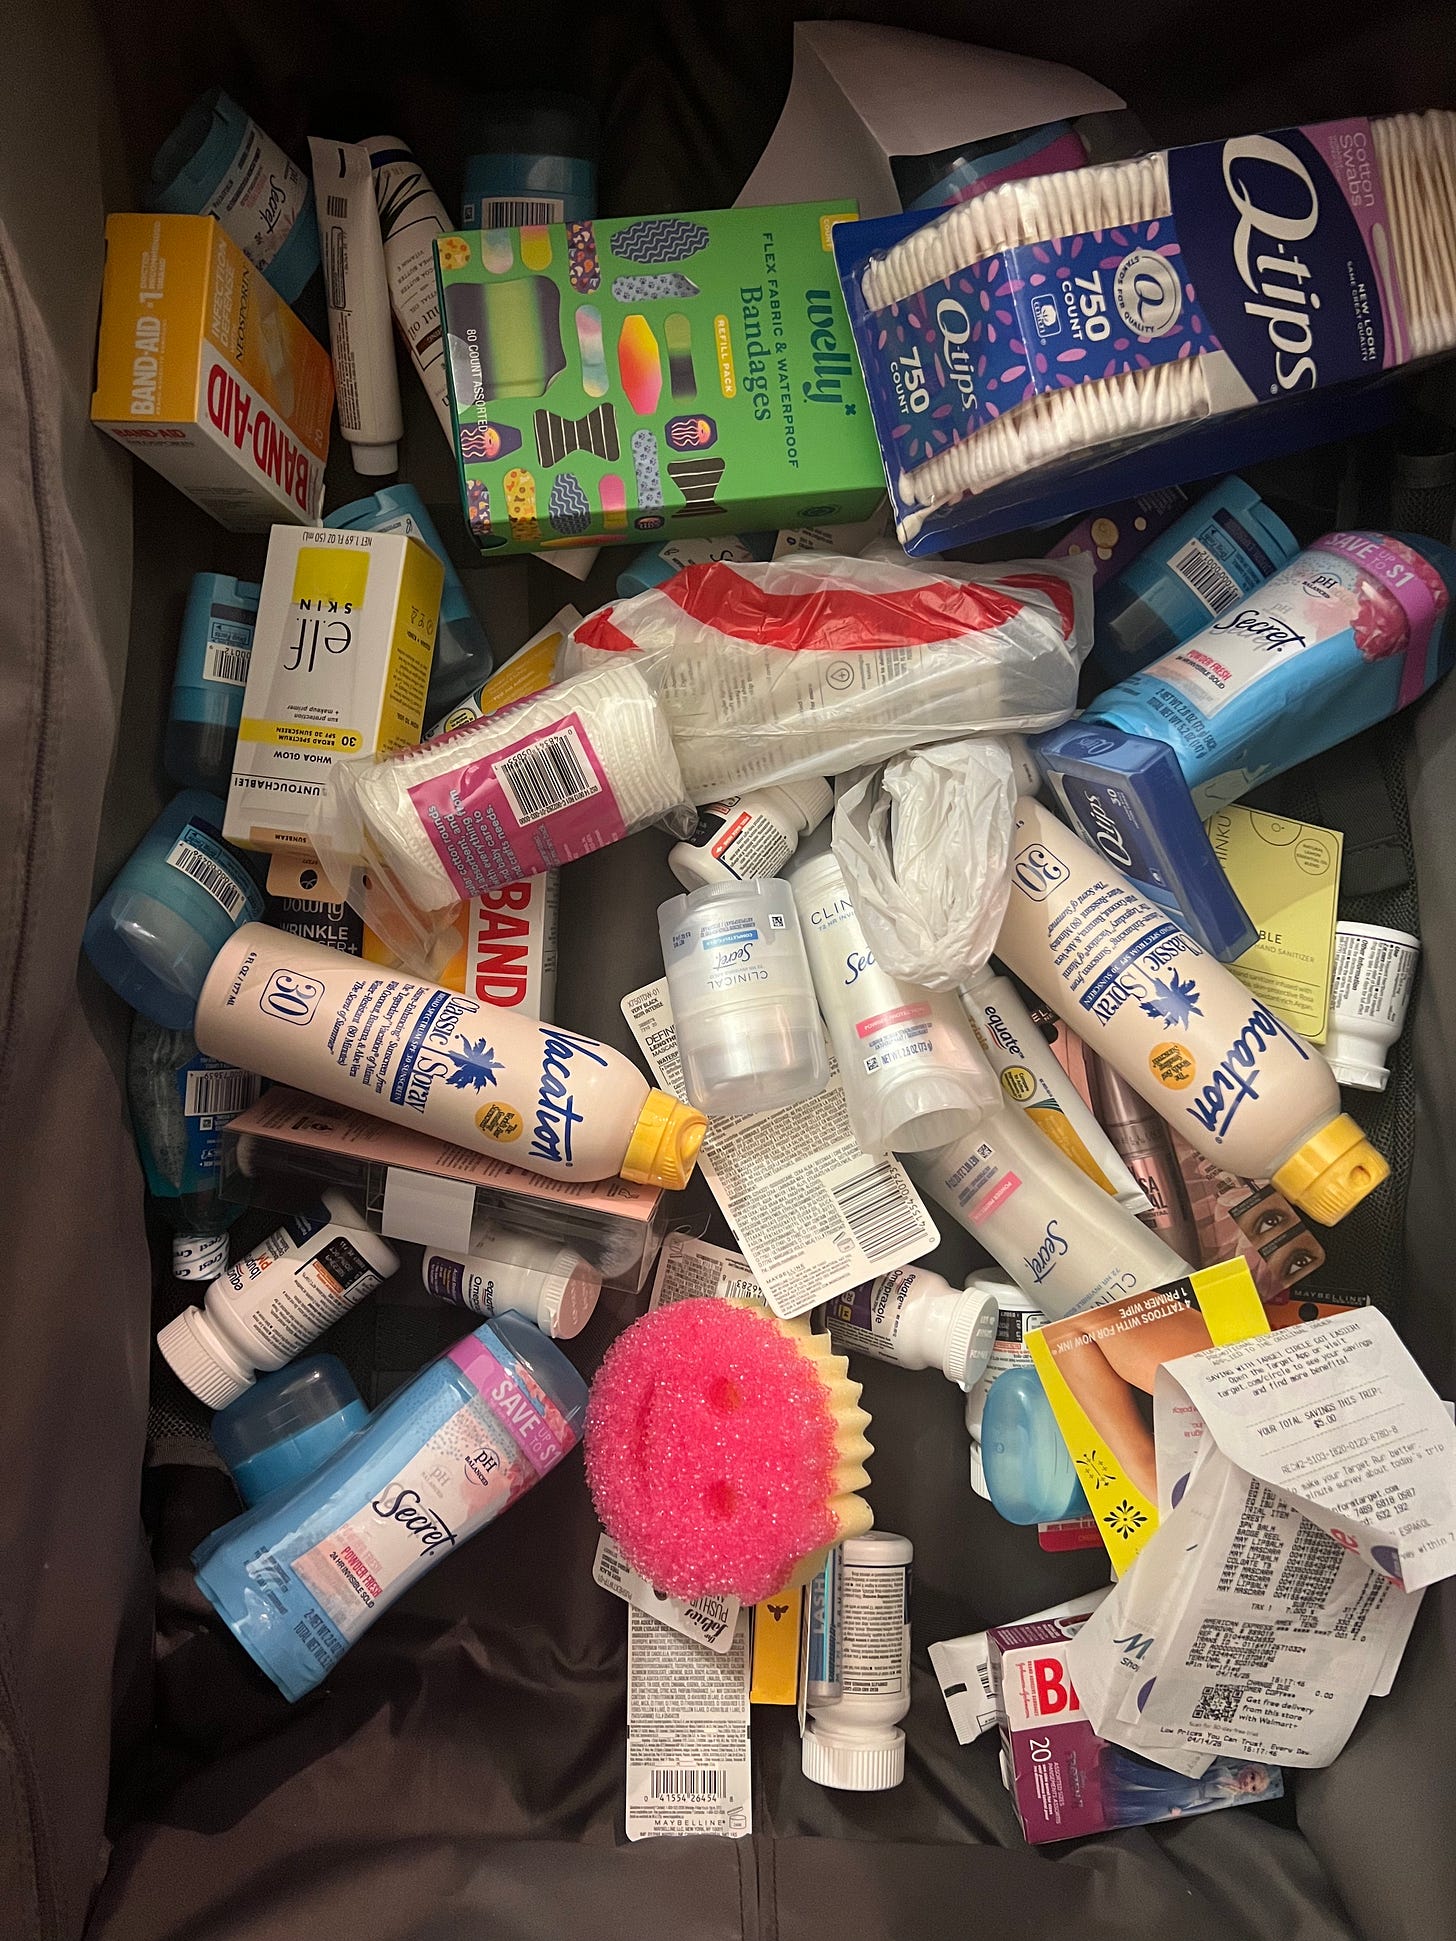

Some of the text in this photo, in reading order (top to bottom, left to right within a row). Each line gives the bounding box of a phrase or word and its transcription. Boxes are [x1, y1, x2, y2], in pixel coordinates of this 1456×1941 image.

[1337, 134, 1362, 206] Swabs
[1353, 132, 1374, 207] Cotton
[260, 173, 287, 234] Secret
[1222, 134, 1320, 389] Q-tips
[210, 238, 228, 338] INFECTION
[221, 263, 236, 348] DEFENSE
[1062, 281, 1083, 340] COUNT
[1074, 270, 1110, 342] 750
[1114, 256, 1156, 339] STANDS FOR QUALITY
[1348, 288, 1364, 318] GREAT
[235, 263, 251, 363] NEOSPORIN
[405, 320, 425, 340] oil
[1353, 282, 1381, 360] NEW LOOK!
[715, 319, 733, 393] REFILL PACK
[729, 285, 780, 422] Bandages
[760, 231, 801, 469] FLEX FABRIC & WATERPROOF
[789, 286, 856, 407] welly
[935, 298, 978, 411] Q-tips
[1351, 321, 1372, 362] QUALITY
[465, 328, 489, 432] 80 COUNT ASSORTED
[889, 361, 908, 415] COUNT
[898, 346, 931, 414] 750
[207, 363, 309, 511] BAND-AID
[315, 532, 372, 547] NET 1.69 FL OZ (50
[1326, 532, 1378, 560] SAVE
[299, 597, 352, 613] SKIN
[1311, 571, 1338, 592] pH
[1213, 604, 1305, 651] Secret
[1209, 662, 1232, 681] FRESH
[275, 726, 312, 736] SUNSCREEN
[277, 733, 334, 745] BROAD SPECTRUM
[341, 735, 356, 746] 30
[273, 750, 331, 763] WHOA GLOW
[233, 776, 321, 796] UNTOUCHABLE!
[274, 833, 306, 843] SUNBEAM
[426, 804, 468, 876] cotton rounds
[446, 788, 494, 869] everything from
[471, 809, 496, 847] care to
[482, 804, 507, 840] needs.
[443, 812, 487, 884] absorbent, and
[1015, 848, 1062, 892] 30
[713, 943, 752, 968] Secret
[1277, 948, 1314, 963] SANITIZER
[1359, 940, 1367, 956] Other
[264, 971, 318, 1022] 30
[705, 970, 768, 990] CLINICAL
[1085, 932, 1203, 1033] Classic Spray
[391, 991, 444, 1102] BROAD SPECTRUM SPF 30 SUNSCREEN
[400, 996, 480, 1115] Classic Spray
[528, 1029, 607, 1162] Vacation
[889, 1166, 911, 1199] 00753
[1023, 1219, 1068, 1282] Secret
[874, 1269, 902, 1323] Omeprazole
[1118, 1286, 1187, 1318] 1 PRIMER WIPE
[1293, 1289, 1369, 1304] MAYBELLINE
[1056, 1298, 1192, 1353] 4 TATTOOS WITH FOR NOW INK
[1216, 1366, 1293, 1399] target.com/circle
[1305, 1357, 1320, 1368] see
[1321, 1350, 1340, 1364] your
[1340, 1337, 1373, 1356] savings
[1227, 1337, 1347, 1384] Open the Target App visit
[486, 1378, 544, 1438] SAVE
[1256, 1385, 1381, 1438] YOUR TOTAL SAVINGS THIS TRIP:
[1312, 1413, 1337, 1429] $5.00
[526, 1435, 544, 1453] TO
[535, 1427, 552, 1444] UP
[461, 1455, 491, 1487] BALANCED
[473, 1448, 499, 1474] pH
[1335, 1442, 1445, 1490] survey about today's trip
[1342, 1458, 1370, 1475] Target
[373, 1488, 456, 1555] Secret
[328, 1550, 376, 1609] 24 HR INVISIBLE SOLID
[338, 1546, 384, 1598] POWDER FRESH
[700, 1597, 728, 1622] PUSH
[1242, 1704, 1303, 1721] from this store
[1245, 1696, 1315, 1714] Get free delivery
[1314, 1690, 1333, 1699] 0.00
[1160, 1726, 1173, 1734] Low
[1177, 1728, 1203, 1738] Prices
[1206, 1732, 1220, 1740] You
[1241, 1738, 1264, 1747] Trust.
[1270, 1743, 1293, 1754] Every
[1238, 1713, 1298, 1730] with Walmart+
[1028, 1736, 1052, 1763] 20
[659, 1794, 716, 1802] 41554 26454
[1052, 1762, 1062, 1791] ASSORTED
